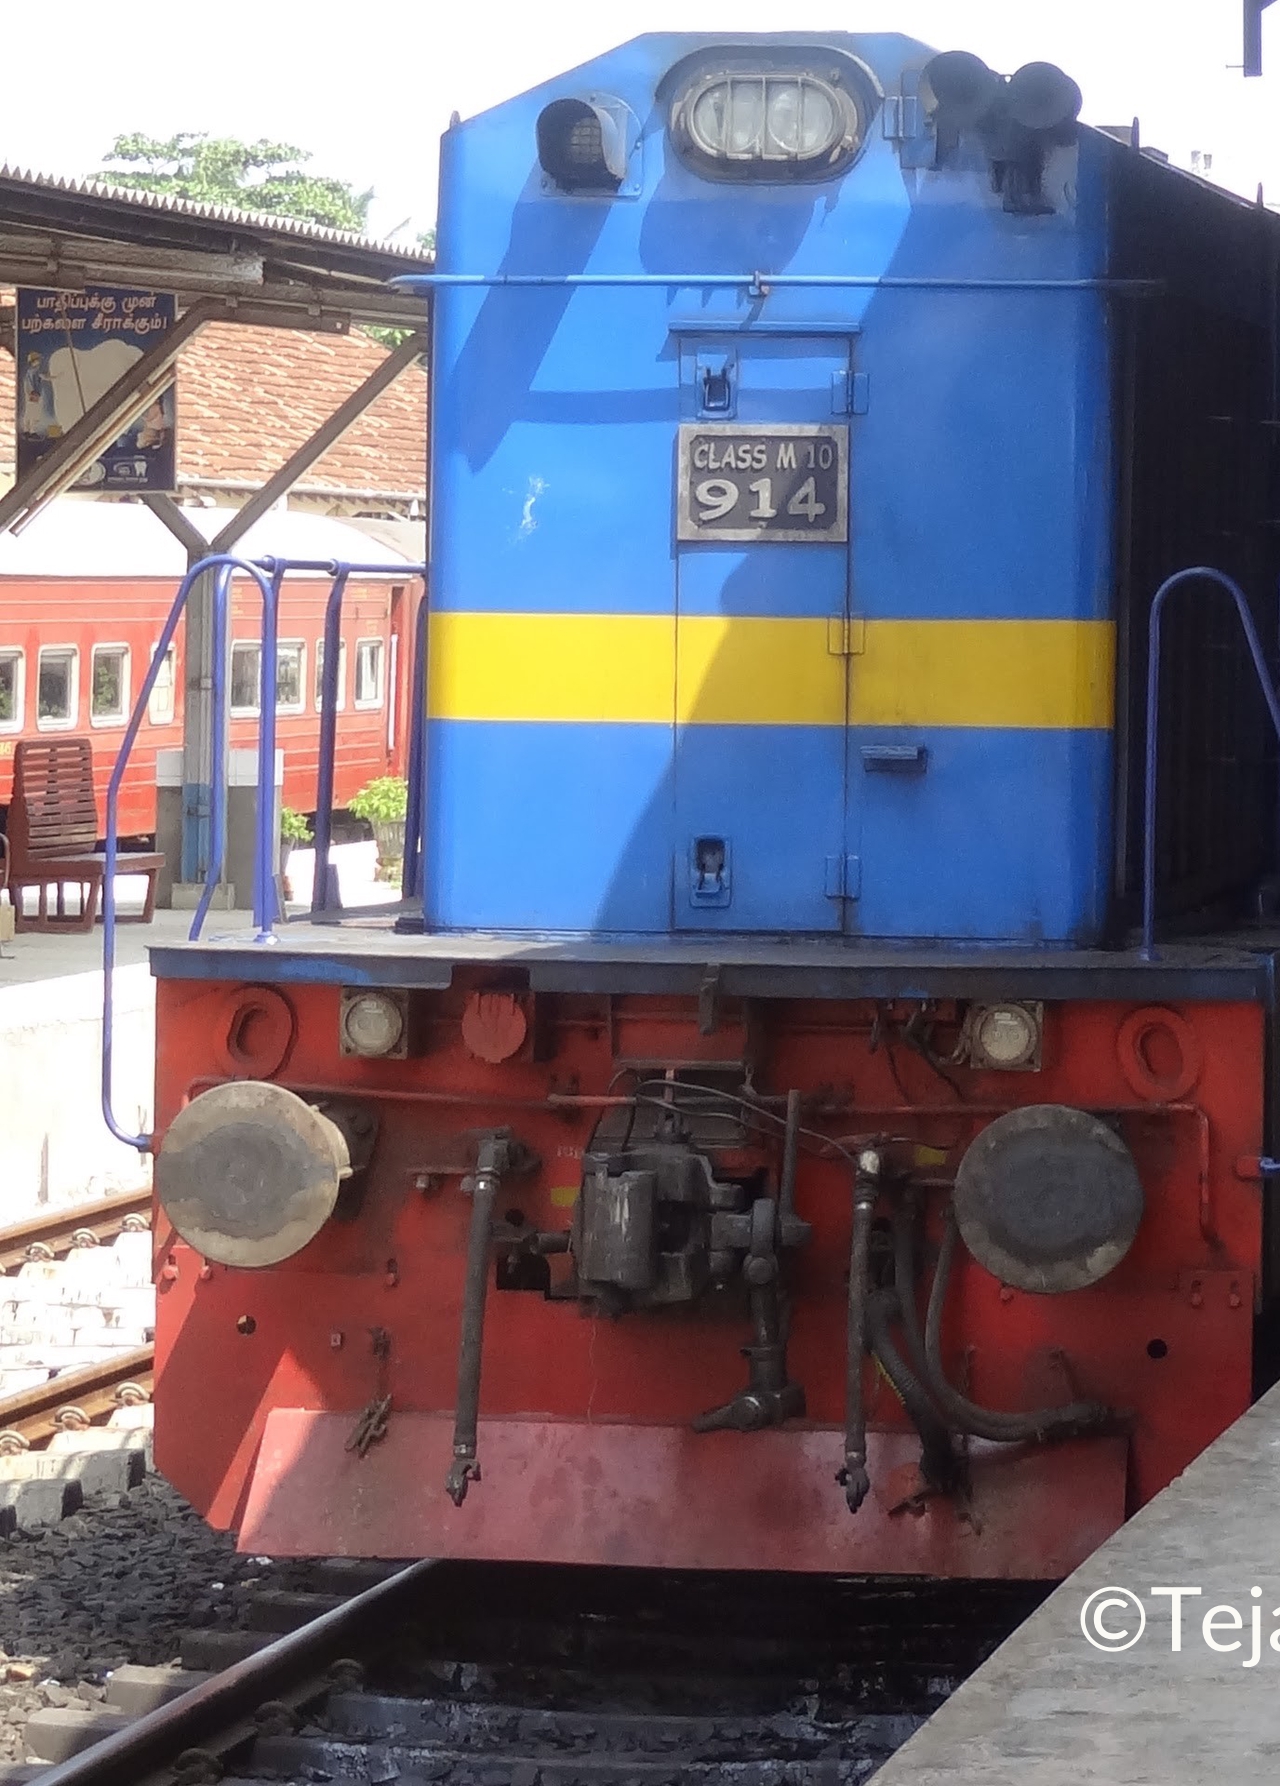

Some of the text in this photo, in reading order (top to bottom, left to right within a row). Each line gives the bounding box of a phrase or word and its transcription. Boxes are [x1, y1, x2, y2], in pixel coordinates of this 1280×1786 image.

[694, 443, 833, 471] CLASS M 10
[695, 476, 826, 523] 914
